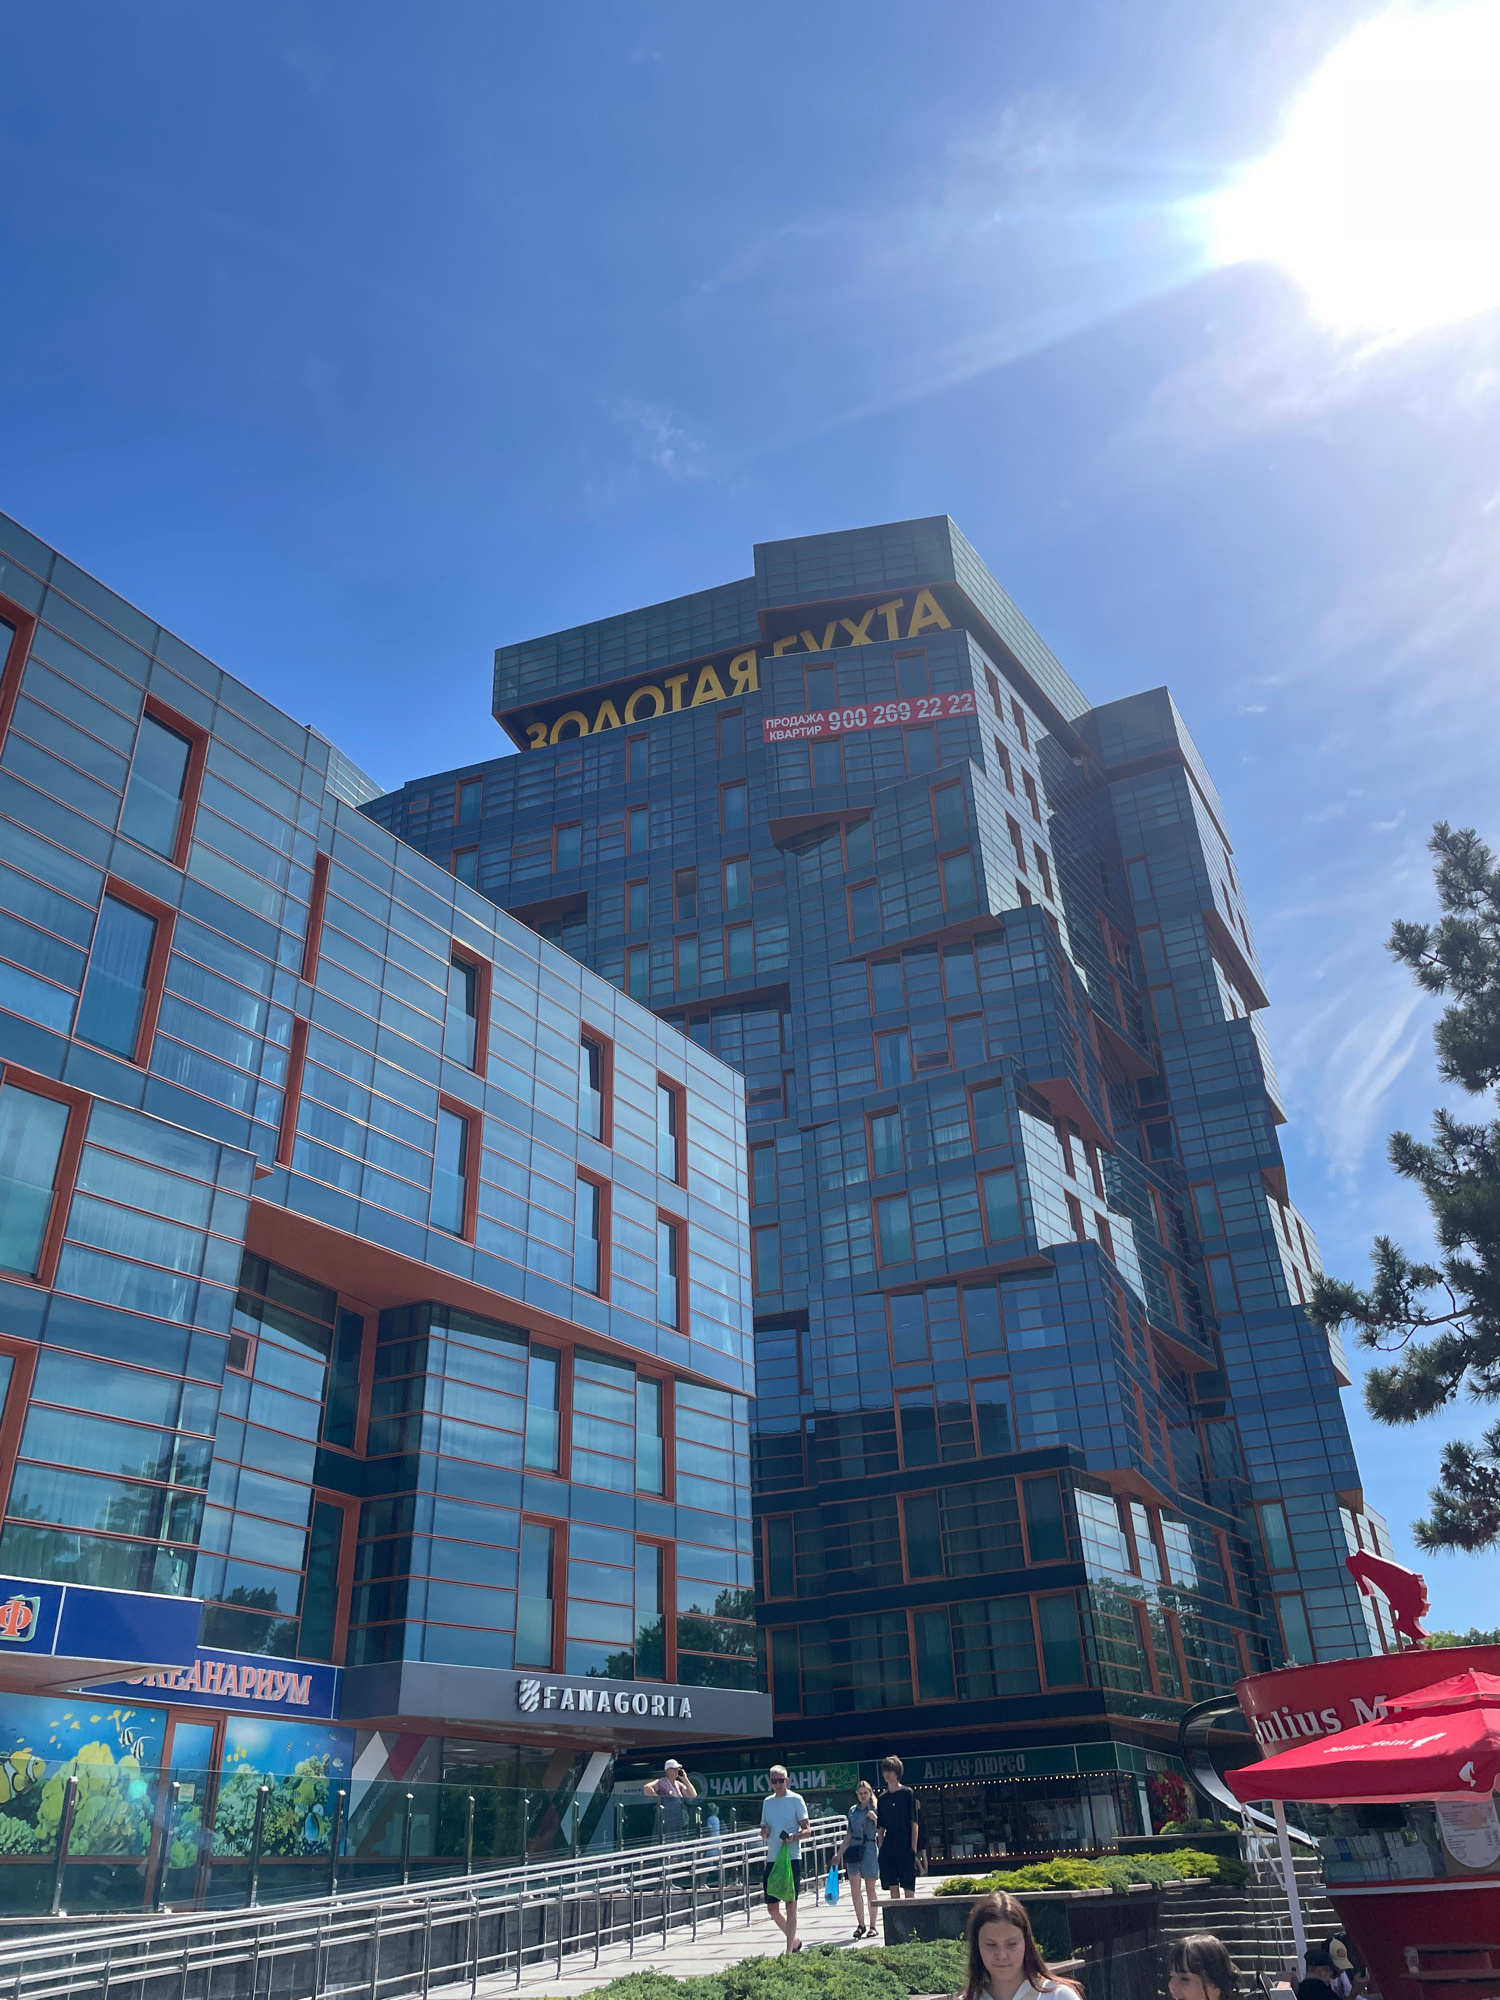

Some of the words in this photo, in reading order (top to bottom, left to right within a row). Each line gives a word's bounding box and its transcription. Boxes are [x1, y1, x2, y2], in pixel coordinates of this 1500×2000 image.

[525, 650, 758, 749] ЗОЛОТАЯ
[828, 707, 868, 731] 900
[873, 701, 911, 725] 269
[916, 697, 943, 719] 22
[947, 692, 974, 714] 22
[765, 712, 825, 730] ПРОДАЖА
[769, 725, 822, 742] КВАРТИР
[543, 1686, 692, 1718] FANAGORIA
[1250, 1706, 1342, 1746] Julius
[1322, 1743, 1367, 1753] Julius
[1370, 1738, 1412, 1748] Meinl
[752, 1769, 826, 1793] КУАНИ
